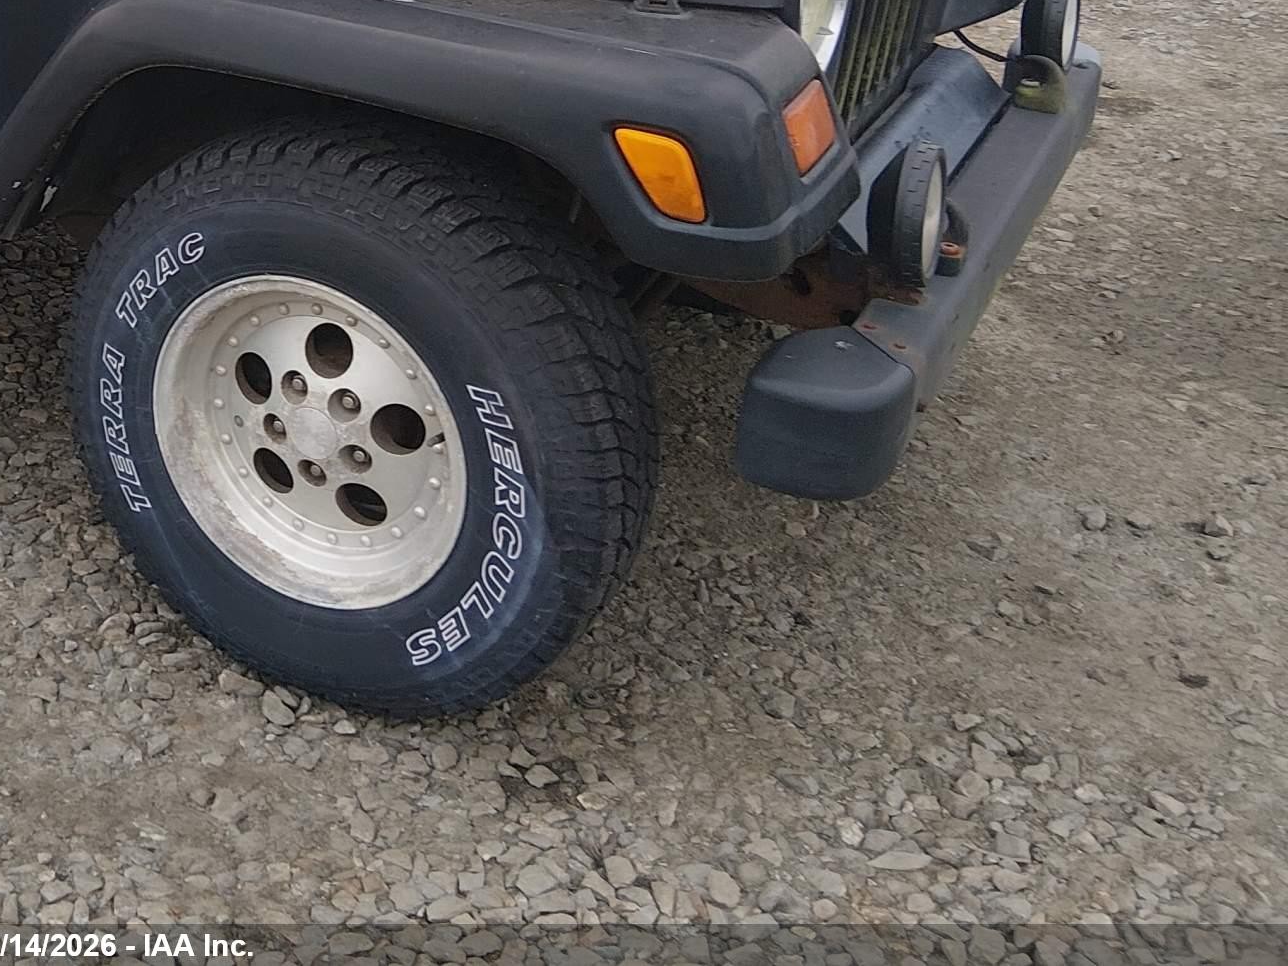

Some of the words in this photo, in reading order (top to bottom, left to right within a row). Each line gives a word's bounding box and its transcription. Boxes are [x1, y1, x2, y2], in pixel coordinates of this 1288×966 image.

[115, 232, 206, 328] TRAC
[98, 343, 152, 513] TERRA
[405, 383, 525, 666] HERCULES
